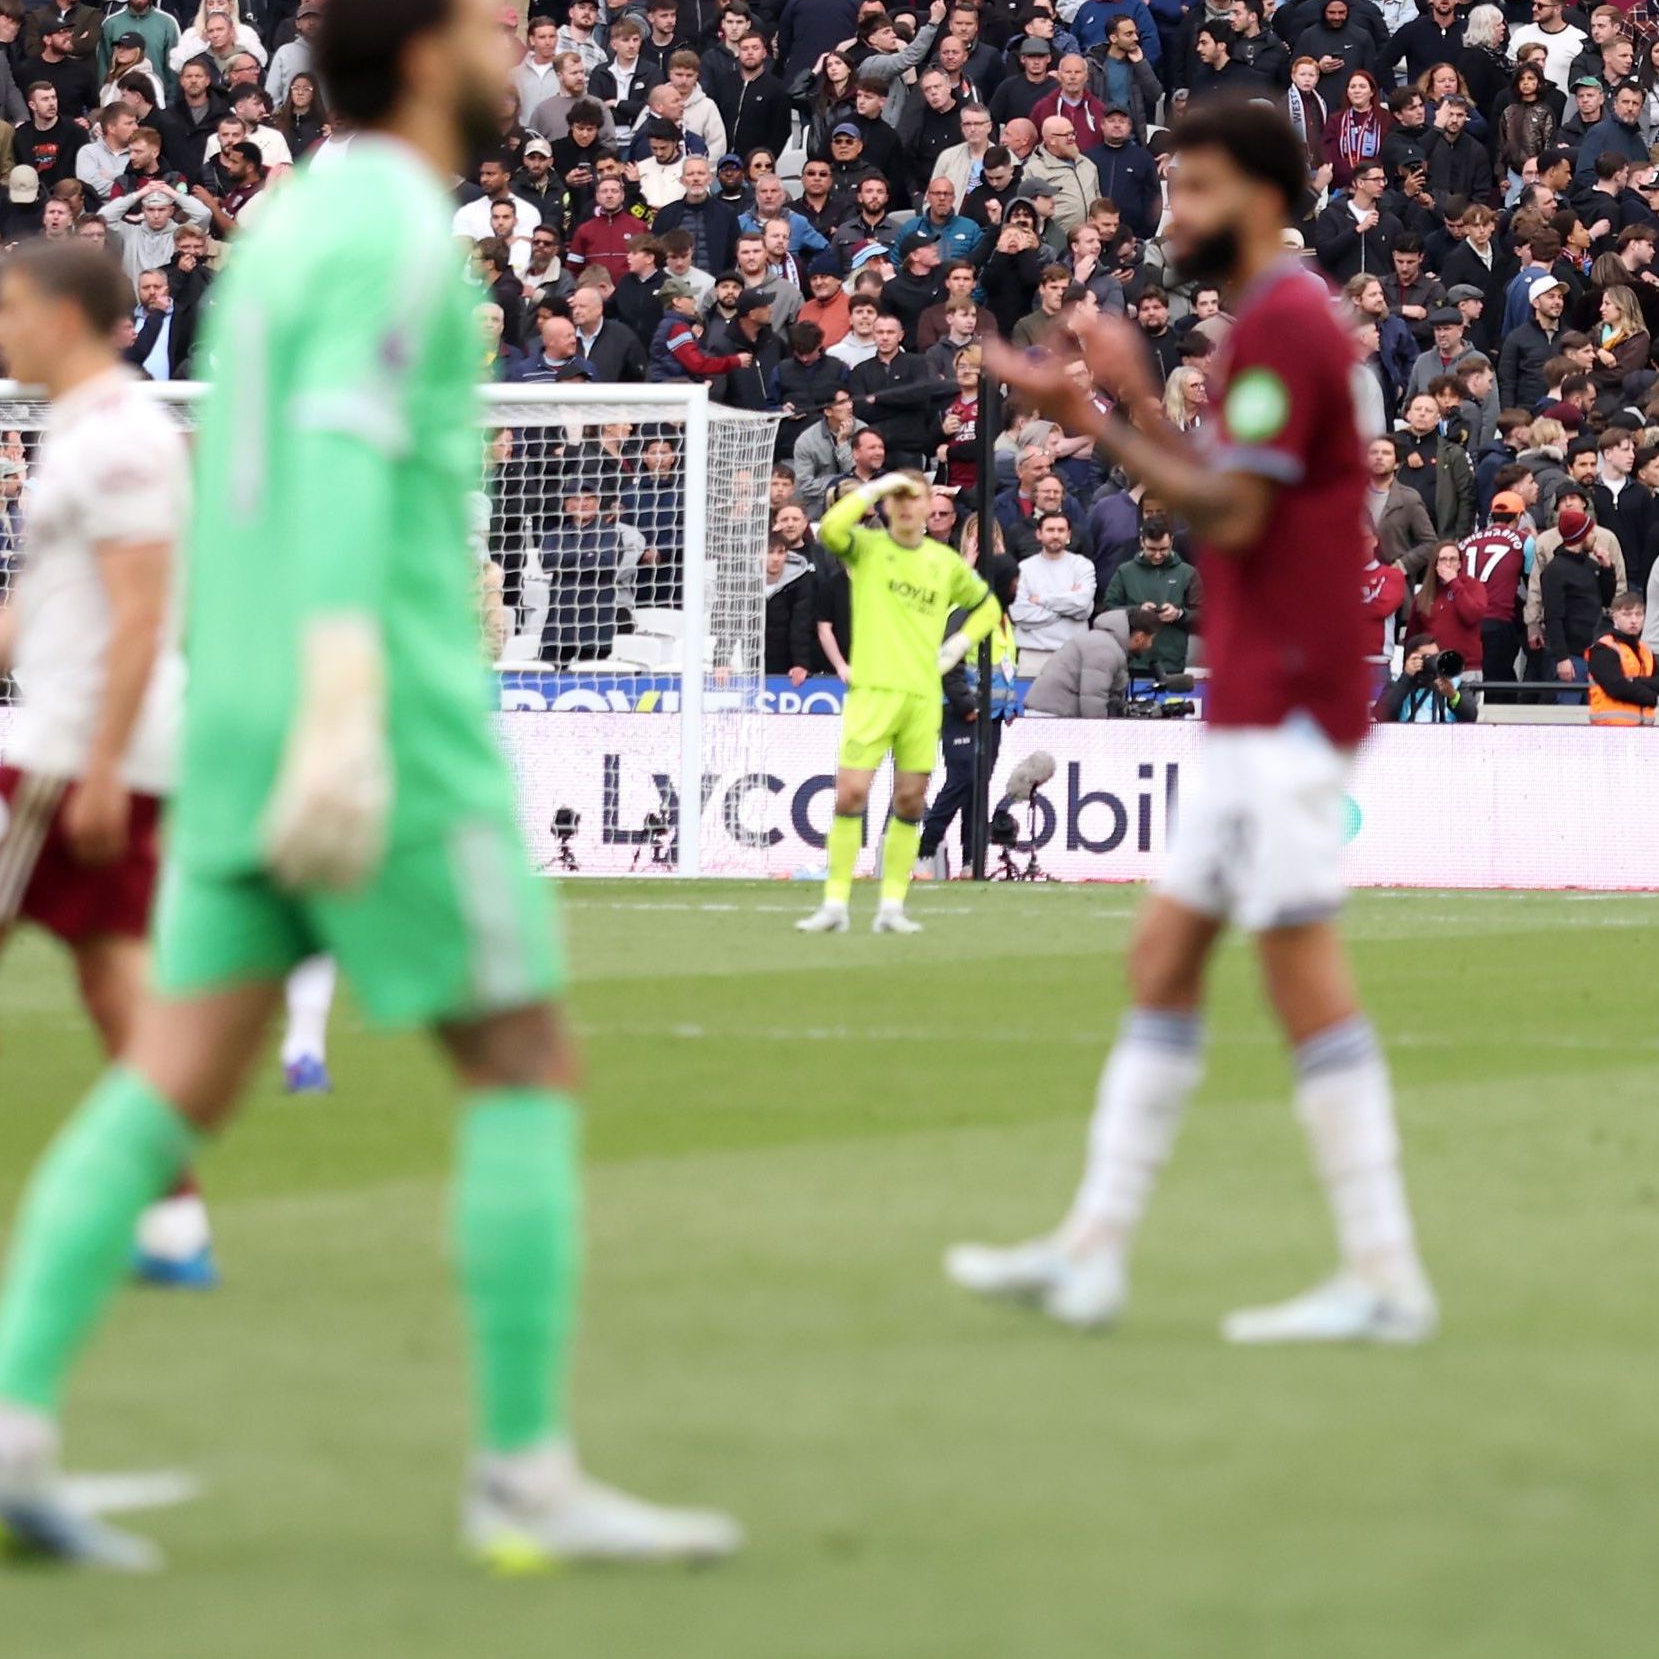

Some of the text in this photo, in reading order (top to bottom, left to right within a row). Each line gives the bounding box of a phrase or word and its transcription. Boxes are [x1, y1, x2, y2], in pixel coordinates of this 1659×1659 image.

[1458, 528, 1523, 551] CHICHARITO
[1465, 544, 1511, 583] 17
[602, 753, 1180, 865] Lycaobil
